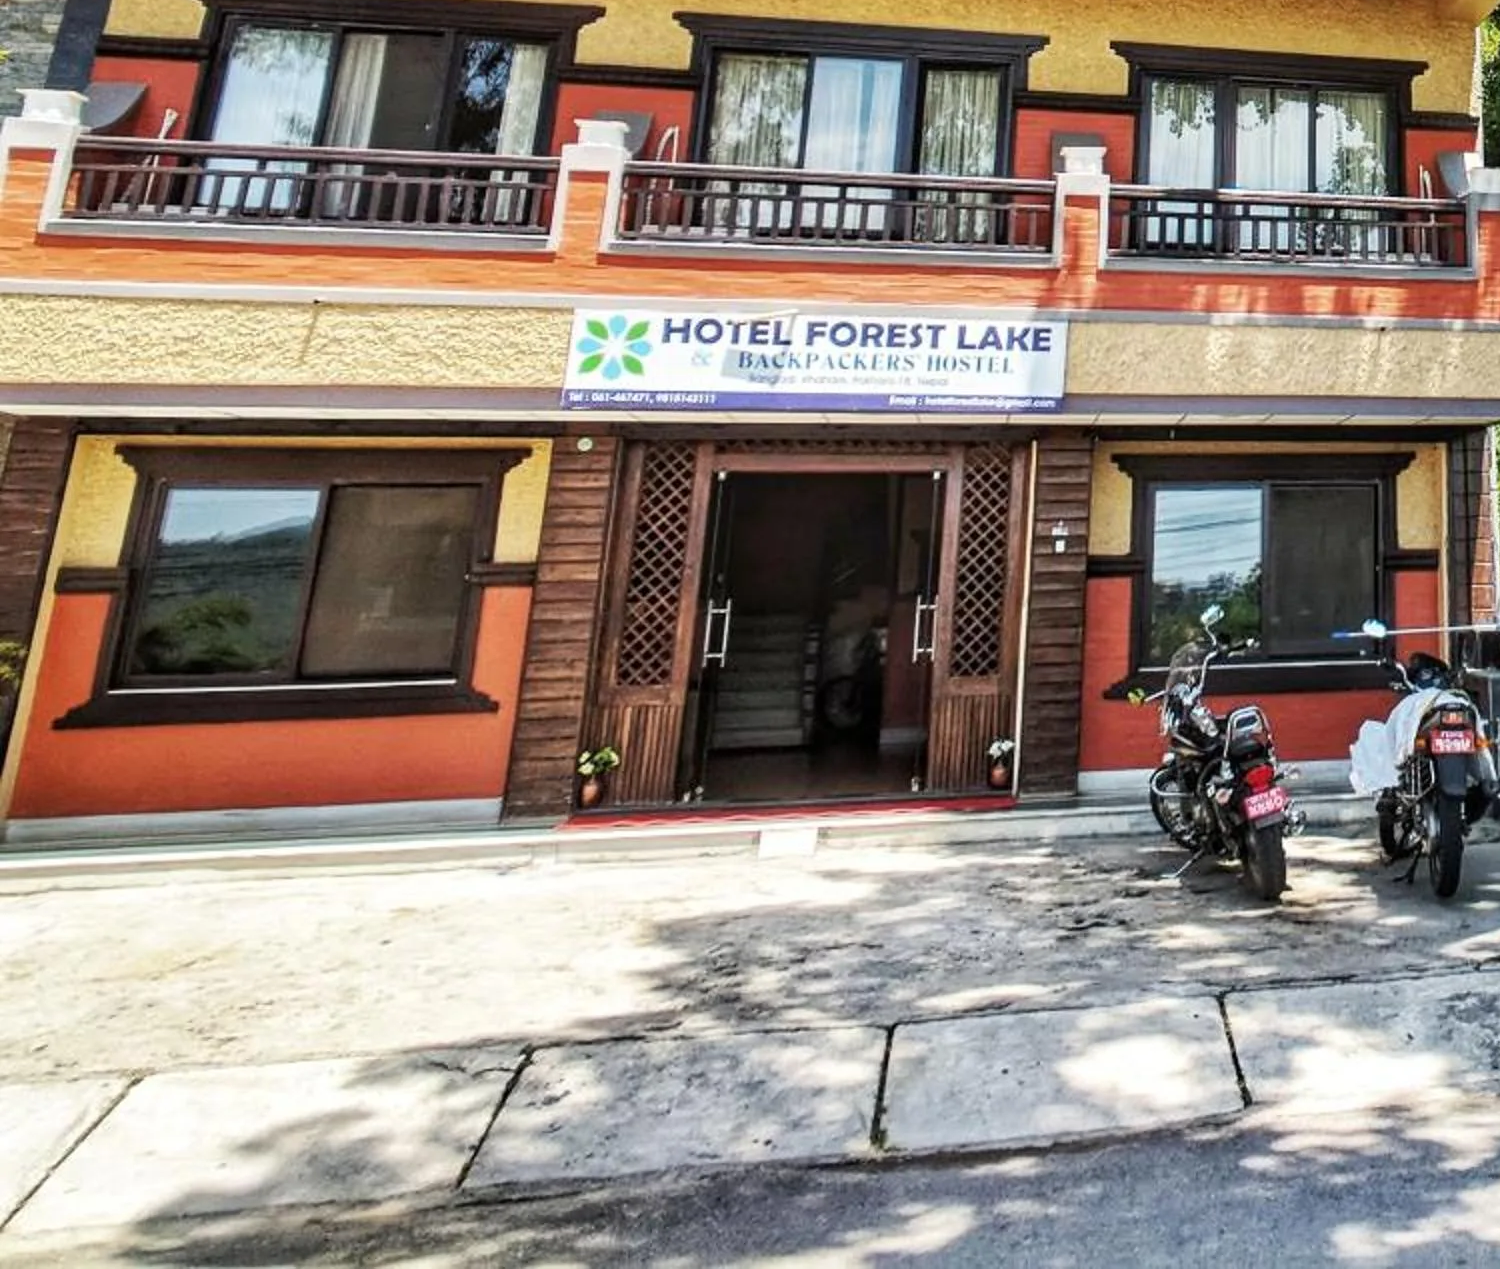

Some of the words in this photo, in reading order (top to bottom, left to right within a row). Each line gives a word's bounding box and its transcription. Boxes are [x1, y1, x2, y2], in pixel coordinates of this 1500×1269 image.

[661, 317, 792, 346] HOTEL
[805, 321, 946, 349] FOREST
[957, 324, 1053, 352] LAKE
[927, 354, 1015, 374] HOSTEL
